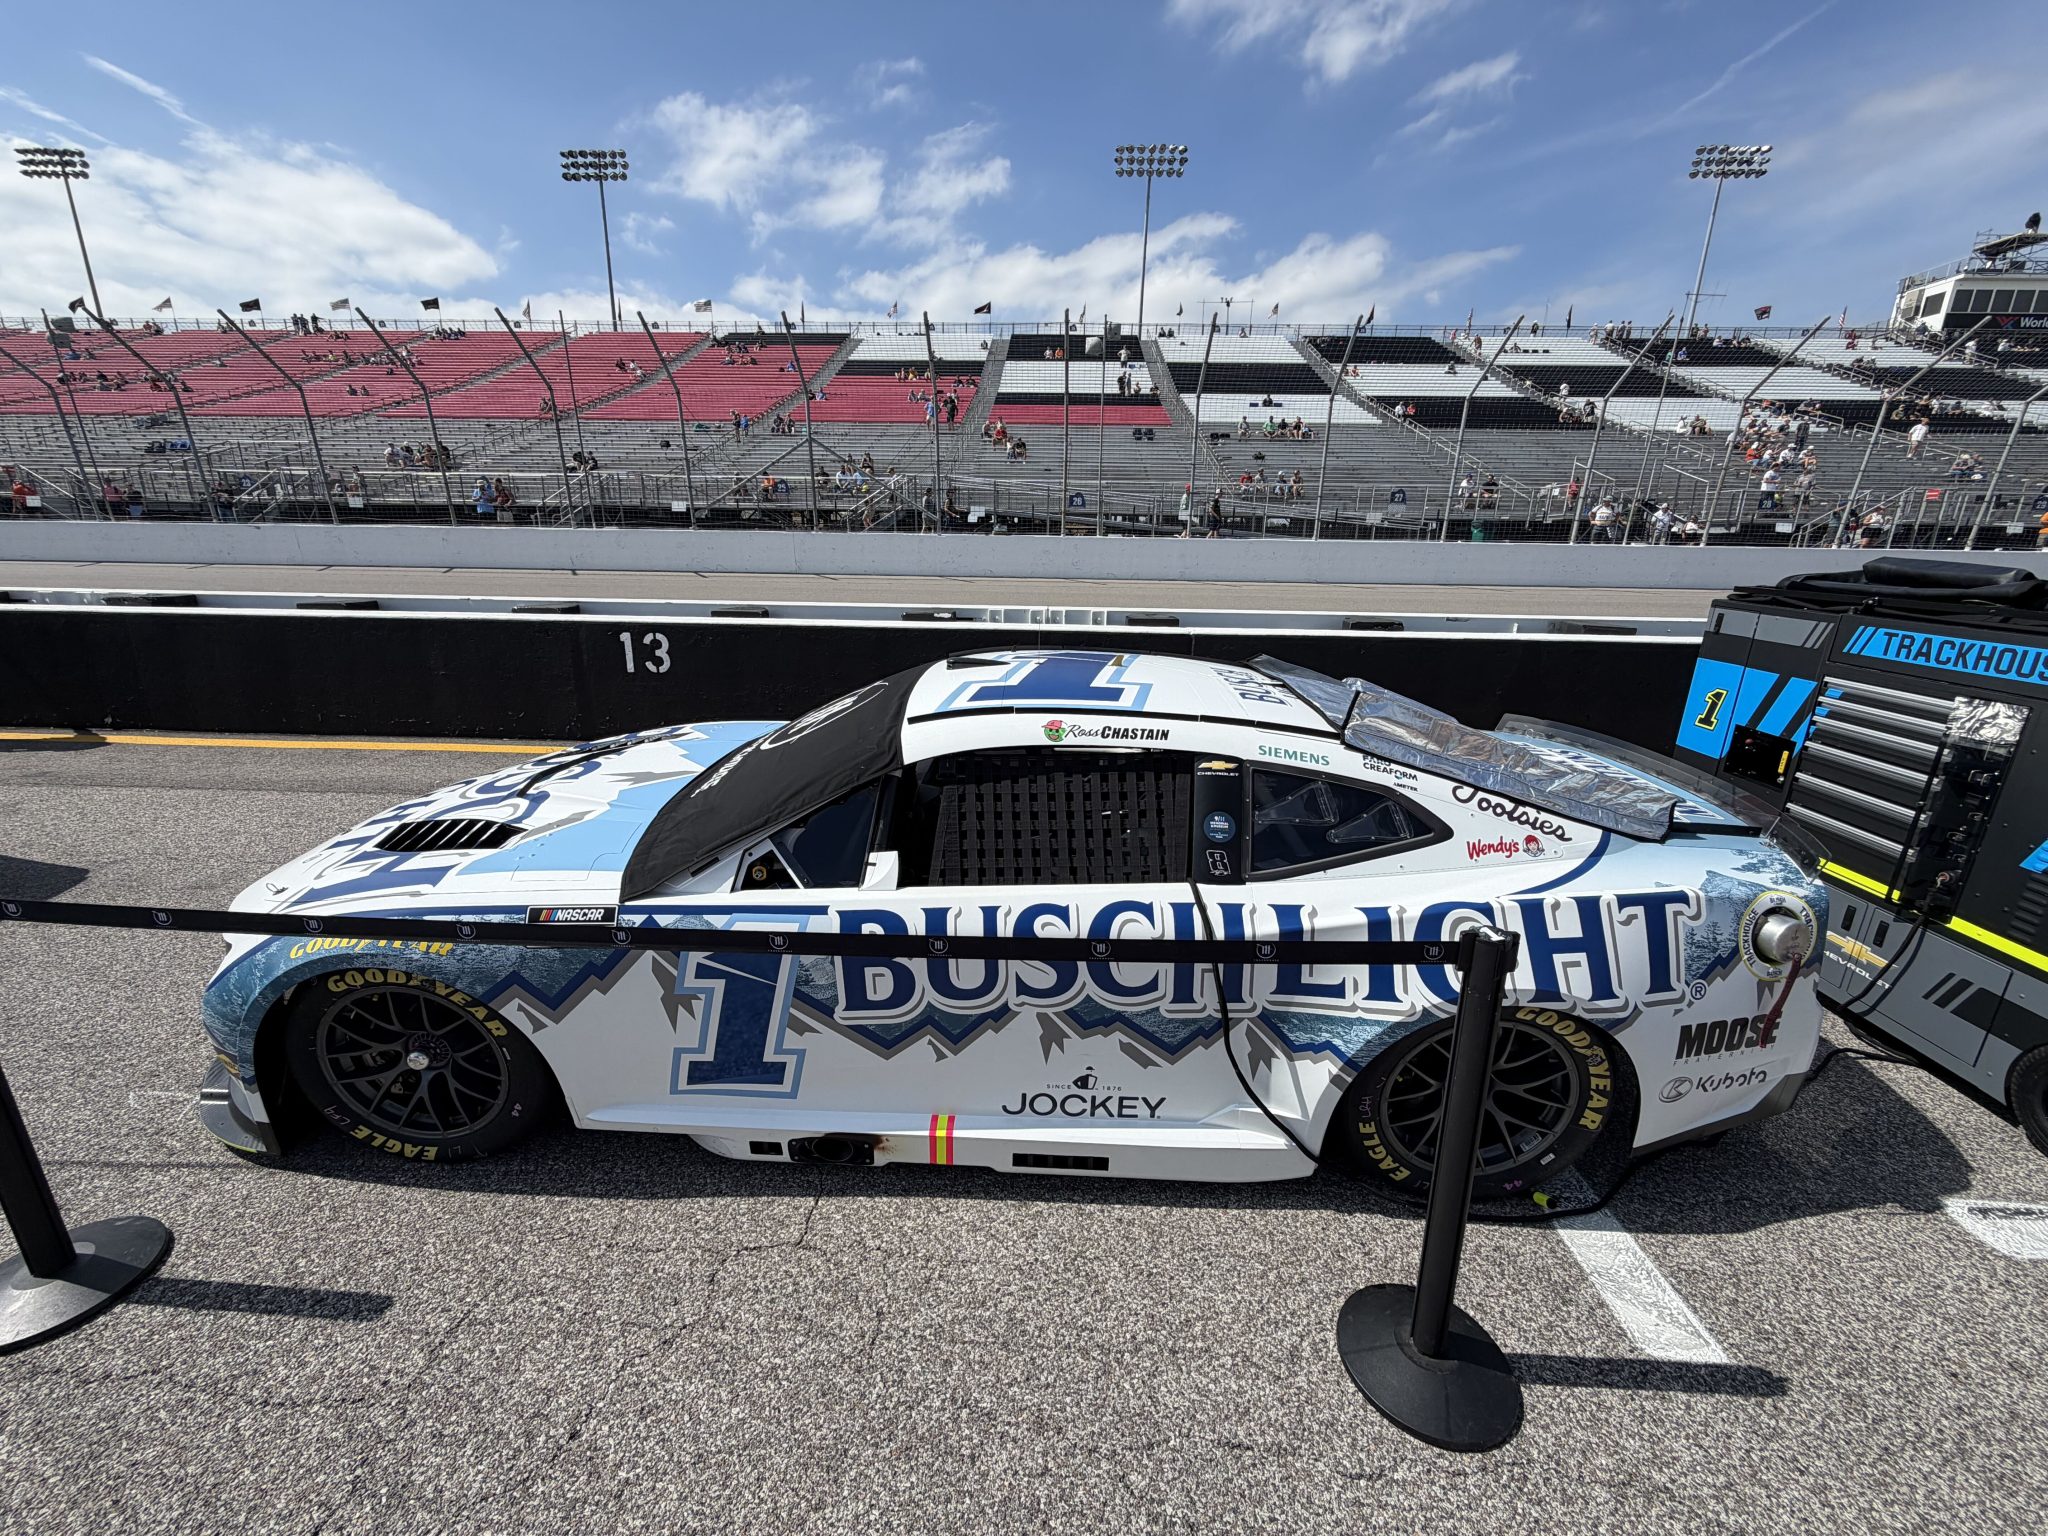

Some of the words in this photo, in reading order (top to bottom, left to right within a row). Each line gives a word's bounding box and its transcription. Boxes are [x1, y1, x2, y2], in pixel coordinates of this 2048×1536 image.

[1394, 493, 1404, 502] 27
[619, 631, 672, 674] 13
[934, 650, 1154, 712] 1
[1694, 688, 1729, 731] 1
[1064, 724, 1101, 740] Ross
[1100, 725, 1170, 741] CHASTAIN
[1257, 744, 1330, 767] SIEMENS
[1362, 762, 1419, 782] CREAFORM
[1392, 782, 1419, 792] AMETEK
[1466, 835, 1520, 861] Wendy's
[554, 909, 605, 922] NASCAR
[832, 898, 1250, 1018] BUSCH
[1263, 888, 1700, 1008] LIGHT
[1742, 907, 1759, 968] TRACKHOUSE
[1823, 950, 1891, 989] HEVROLET
[327, 967, 508, 1038] GOODYEAR
[669, 912, 812, 1099] 1
[1675, 1010, 1783, 1061] MOOSE
[1515, 1006, 1612, 1131] GOODYEAR
[1695, 1066, 1768, 1093] Kubota
[1001, 1092, 1167, 1119] JOCKEY
[349, 1124, 439, 1161] EAGLE
[1358, 1121, 1412, 1182] EAGLE
